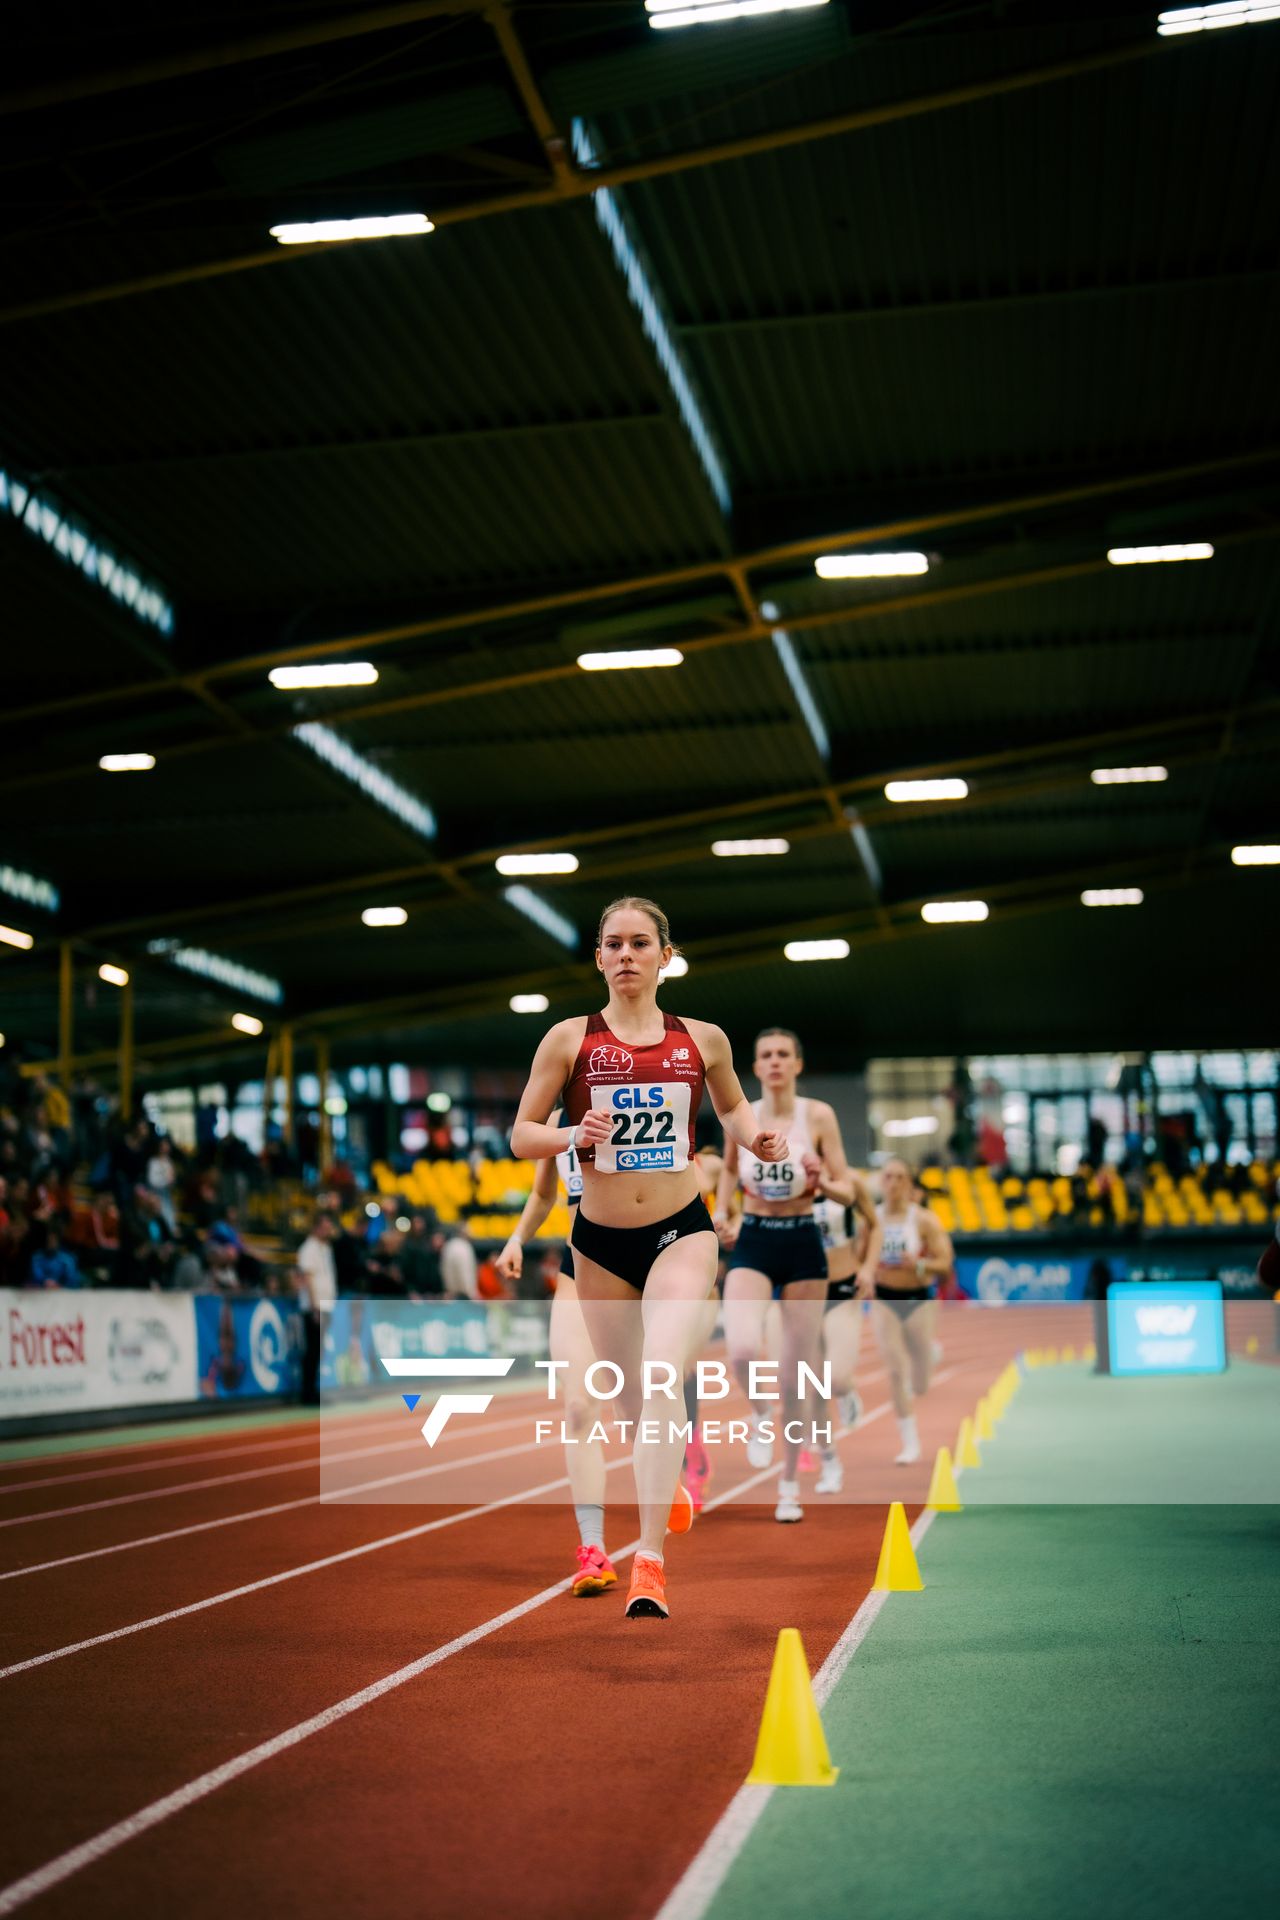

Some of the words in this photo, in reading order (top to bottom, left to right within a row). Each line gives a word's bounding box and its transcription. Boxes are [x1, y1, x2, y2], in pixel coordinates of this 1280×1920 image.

[611, 1111, 677, 1146] 222
[640, 1150, 672, 1162] PLAN
[753, 1163, 794, 1182] 346
[9, 1308, 86, 1367] Forest
